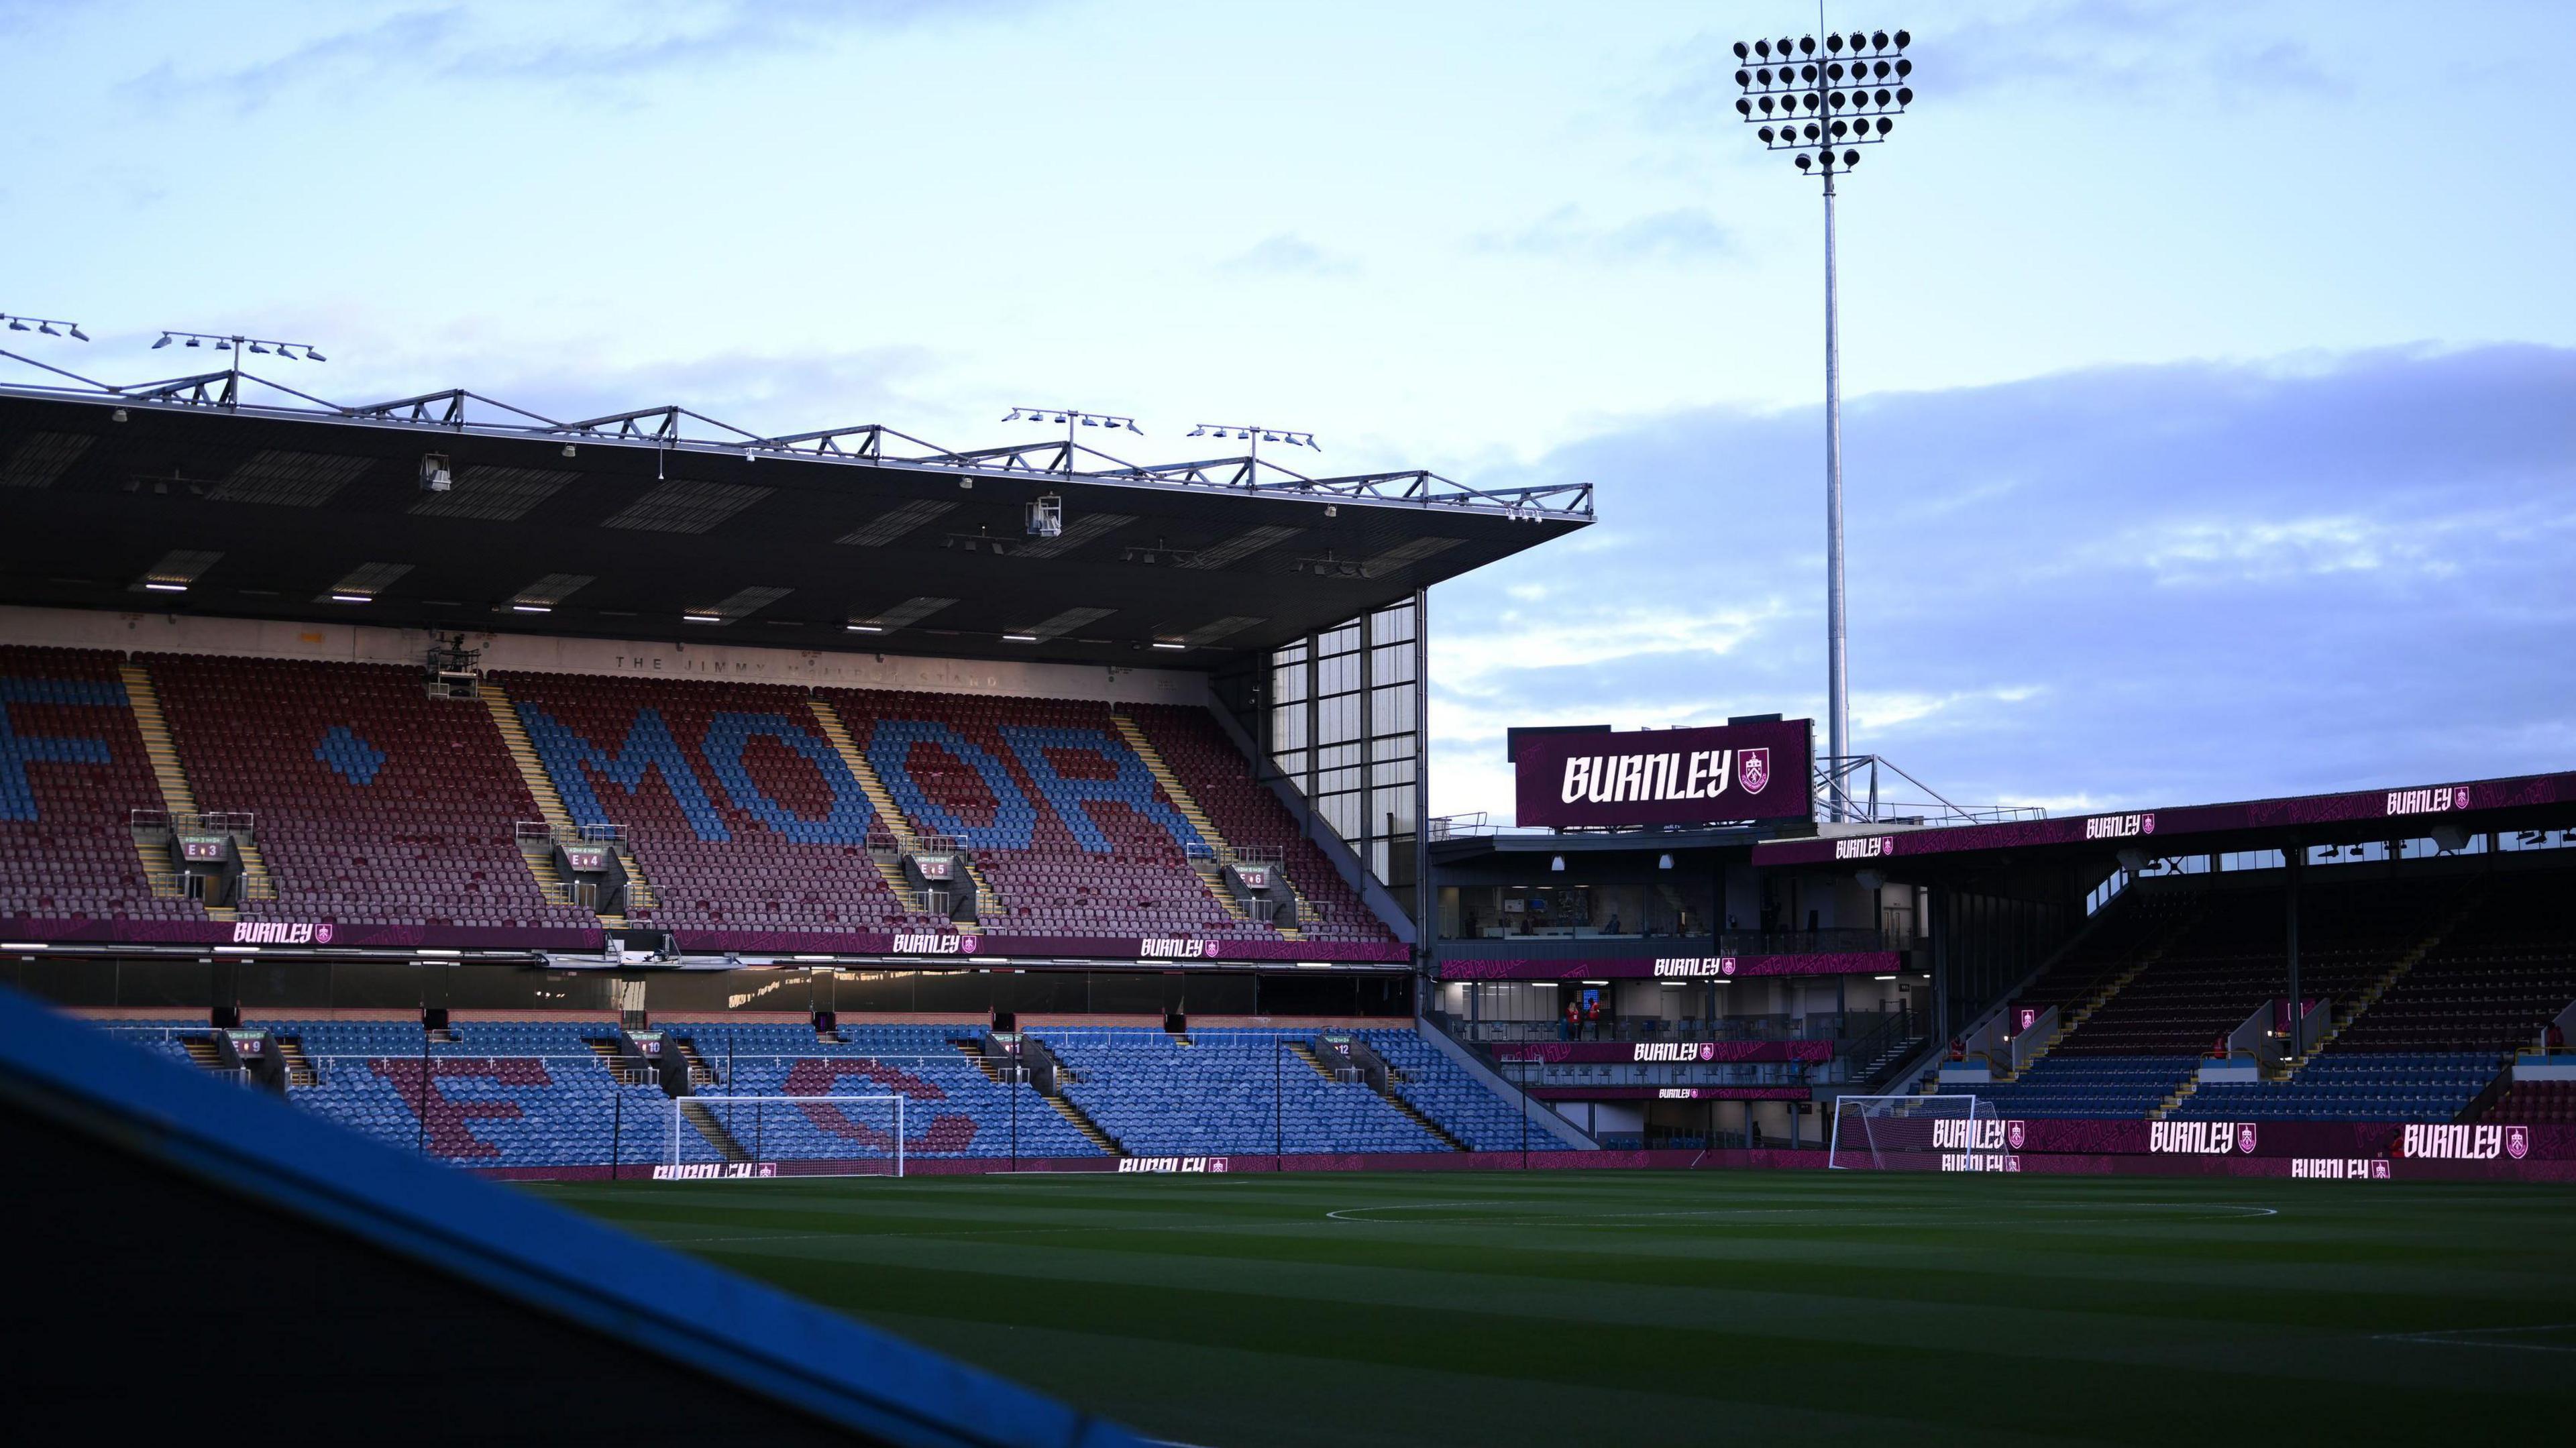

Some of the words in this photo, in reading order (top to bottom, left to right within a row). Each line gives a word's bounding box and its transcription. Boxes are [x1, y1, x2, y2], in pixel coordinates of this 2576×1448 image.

[615, 656, 662, 670] THE
[684, 660, 766, 673] JIMMY
[1561, 749, 1732, 804] BURNLEY
[2387, 787, 2452, 816] BURNLEY
[2086, 814, 2140, 840] BURNLEY
[189, 844, 196, 855] E
[209, 845, 217, 856] 3
[1835, 837, 1882, 860] BURNLEY
[572, 854, 579, 865] E
[591, 856, 598, 866] 4
[921, 864, 927, 874] E
[938, 865, 944, 874] 5
[1255, 874, 1261, 883] 6
[233, 922, 313, 944] BURNLEY
[893, 934, 961, 954] BURNLEY
[1140, 938, 1203, 958] BURNLEY
[1654, 958, 1721, 977] BURNLEY
[253, 1041, 260, 1052] 9
[648, 1042, 660, 1052] 10
[1339, 1044, 1348, 1054] 12
[1633, 1043, 1699, 1062] BURNLEY
[1658, 1089, 1690, 1099] BURNLEY
[1933, 1119, 2006, 1149] BURNLEY
[2150, 1121, 2235, 1154] BURNLEY
[2404, 1124, 2502, 1160] BURNLEY
